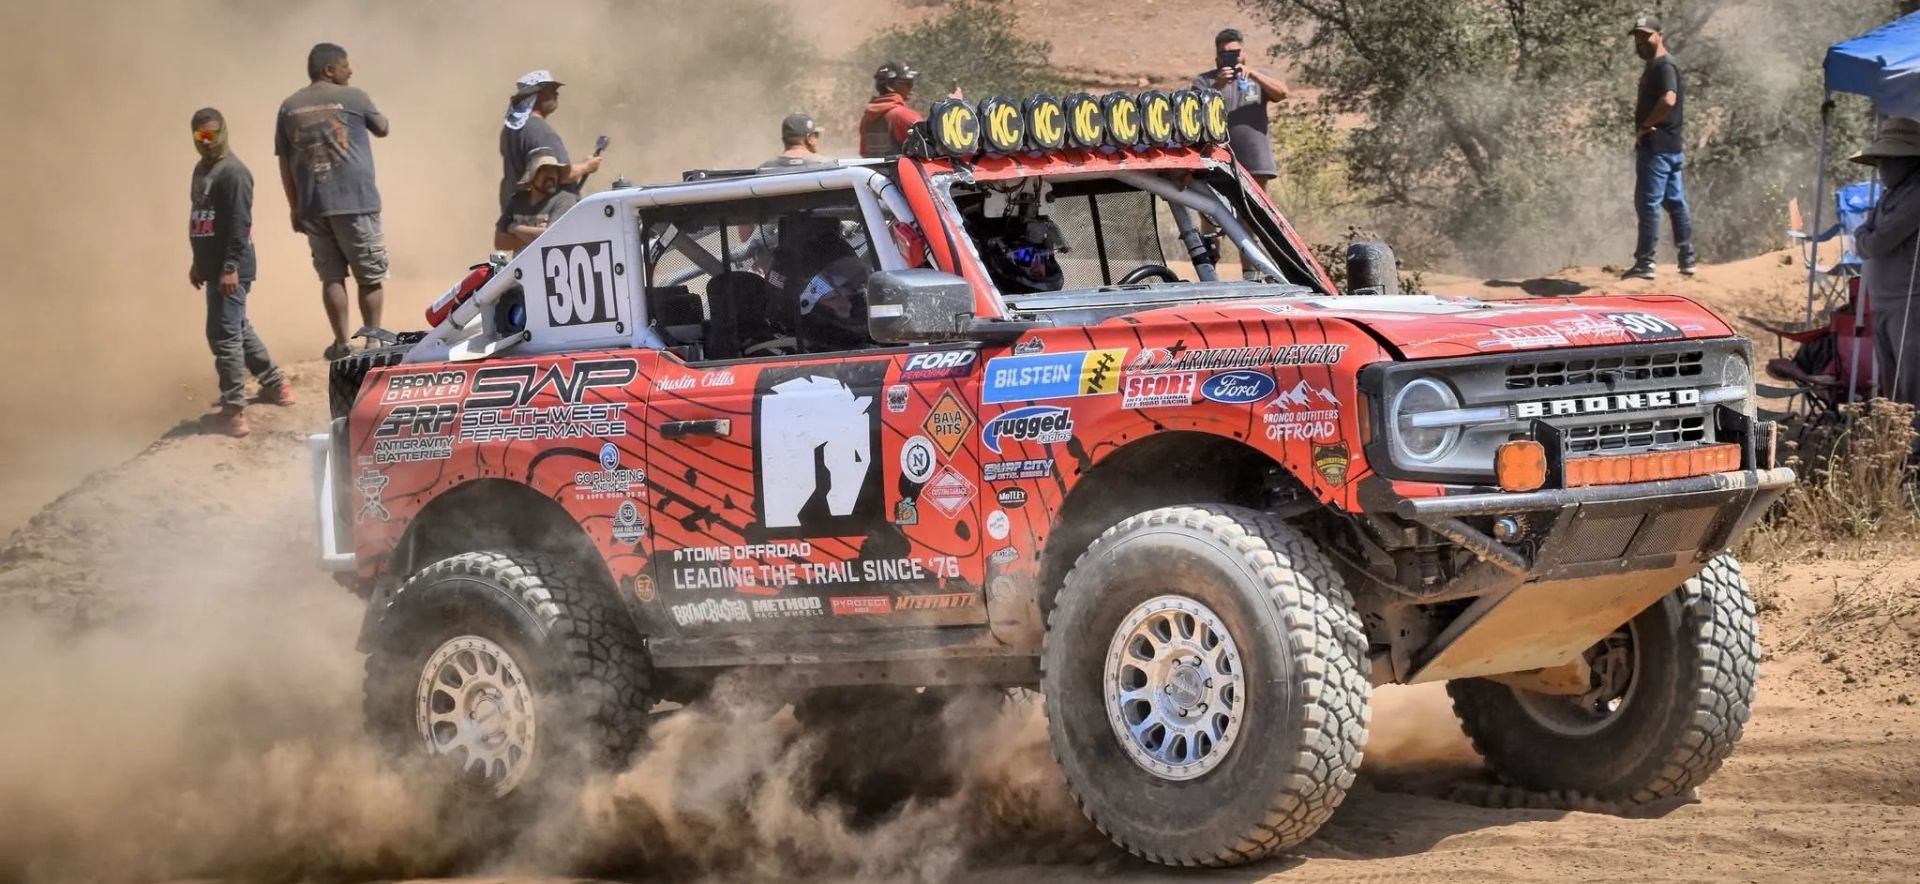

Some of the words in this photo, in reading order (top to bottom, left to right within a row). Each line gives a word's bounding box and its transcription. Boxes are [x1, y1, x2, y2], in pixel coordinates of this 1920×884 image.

[942, 106, 973, 148] KC
[990, 104, 1018, 146] KC
[1034, 102, 1060, 143] KC
[1075, 100, 1100, 141] KC
[1112, 98, 1135, 140] KC
[1148, 97, 1169, 139] KC
[1180, 96, 1200, 137] KC
[1206, 96, 1225, 137] KC
[546, 242, 616, 324] 301
[1607, 313, 1679, 334] 301
[906, 350, 977, 371] FORD
[1177, 347, 1272, 371] ARMADILLO
[1272, 344, 1346, 368] DESIGNS
[389, 371, 465, 388] BRONCO
[464, 358, 639, 409] SWP
[994, 364, 1072, 389] BILSTEIN
[1127, 374, 1194, 398] SCORE
[1214, 375, 1260, 398] Ford
[387, 384, 459, 400] DRIVER
[1126, 394, 1187, 403] INTERNATIONAL
[1161, 398, 1189, 406] RACING
[1516, 389, 1700, 418] BRONCO
[374, 403, 459, 438] PRP
[461, 403, 628, 428] SOUTHWEST
[1263, 412, 1294, 424] BRONCO
[1296, 409, 1339, 422] OUTFITTERS
[459, 421, 627, 444] PERFORMANCE
[936, 423, 962, 436] PITS
[1038, 431, 1072, 443] radios
[1265, 421, 1335, 441] OFFROAD
[374, 436, 454, 453] ANTIGRAVITY
[376, 449, 452, 464] BATTERIES
[912, 453, 924, 467] N
[575, 471, 592, 485] GO
[592, 468, 645, 483] PLUMBING
[1024, 459, 1054, 477] CITY
[592, 481, 608, 492] AND
[608, 480, 630, 491] MORE
[684, 545, 731, 562] TOMS
[734, 542, 812, 560] OFFROAD
[673, 565, 755, 590] LEADING
[759, 563, 796, 587] THE
[801, 561, 860, 585] TRAIL
[863, 557, 924, 582] SINCE
[637, 579, 651, 591] EZ
[751, 596, 822, 612] METHOD
[785, 609, 824, 618] WHEELS
[832, 599, 888, 607] PYROTECT
